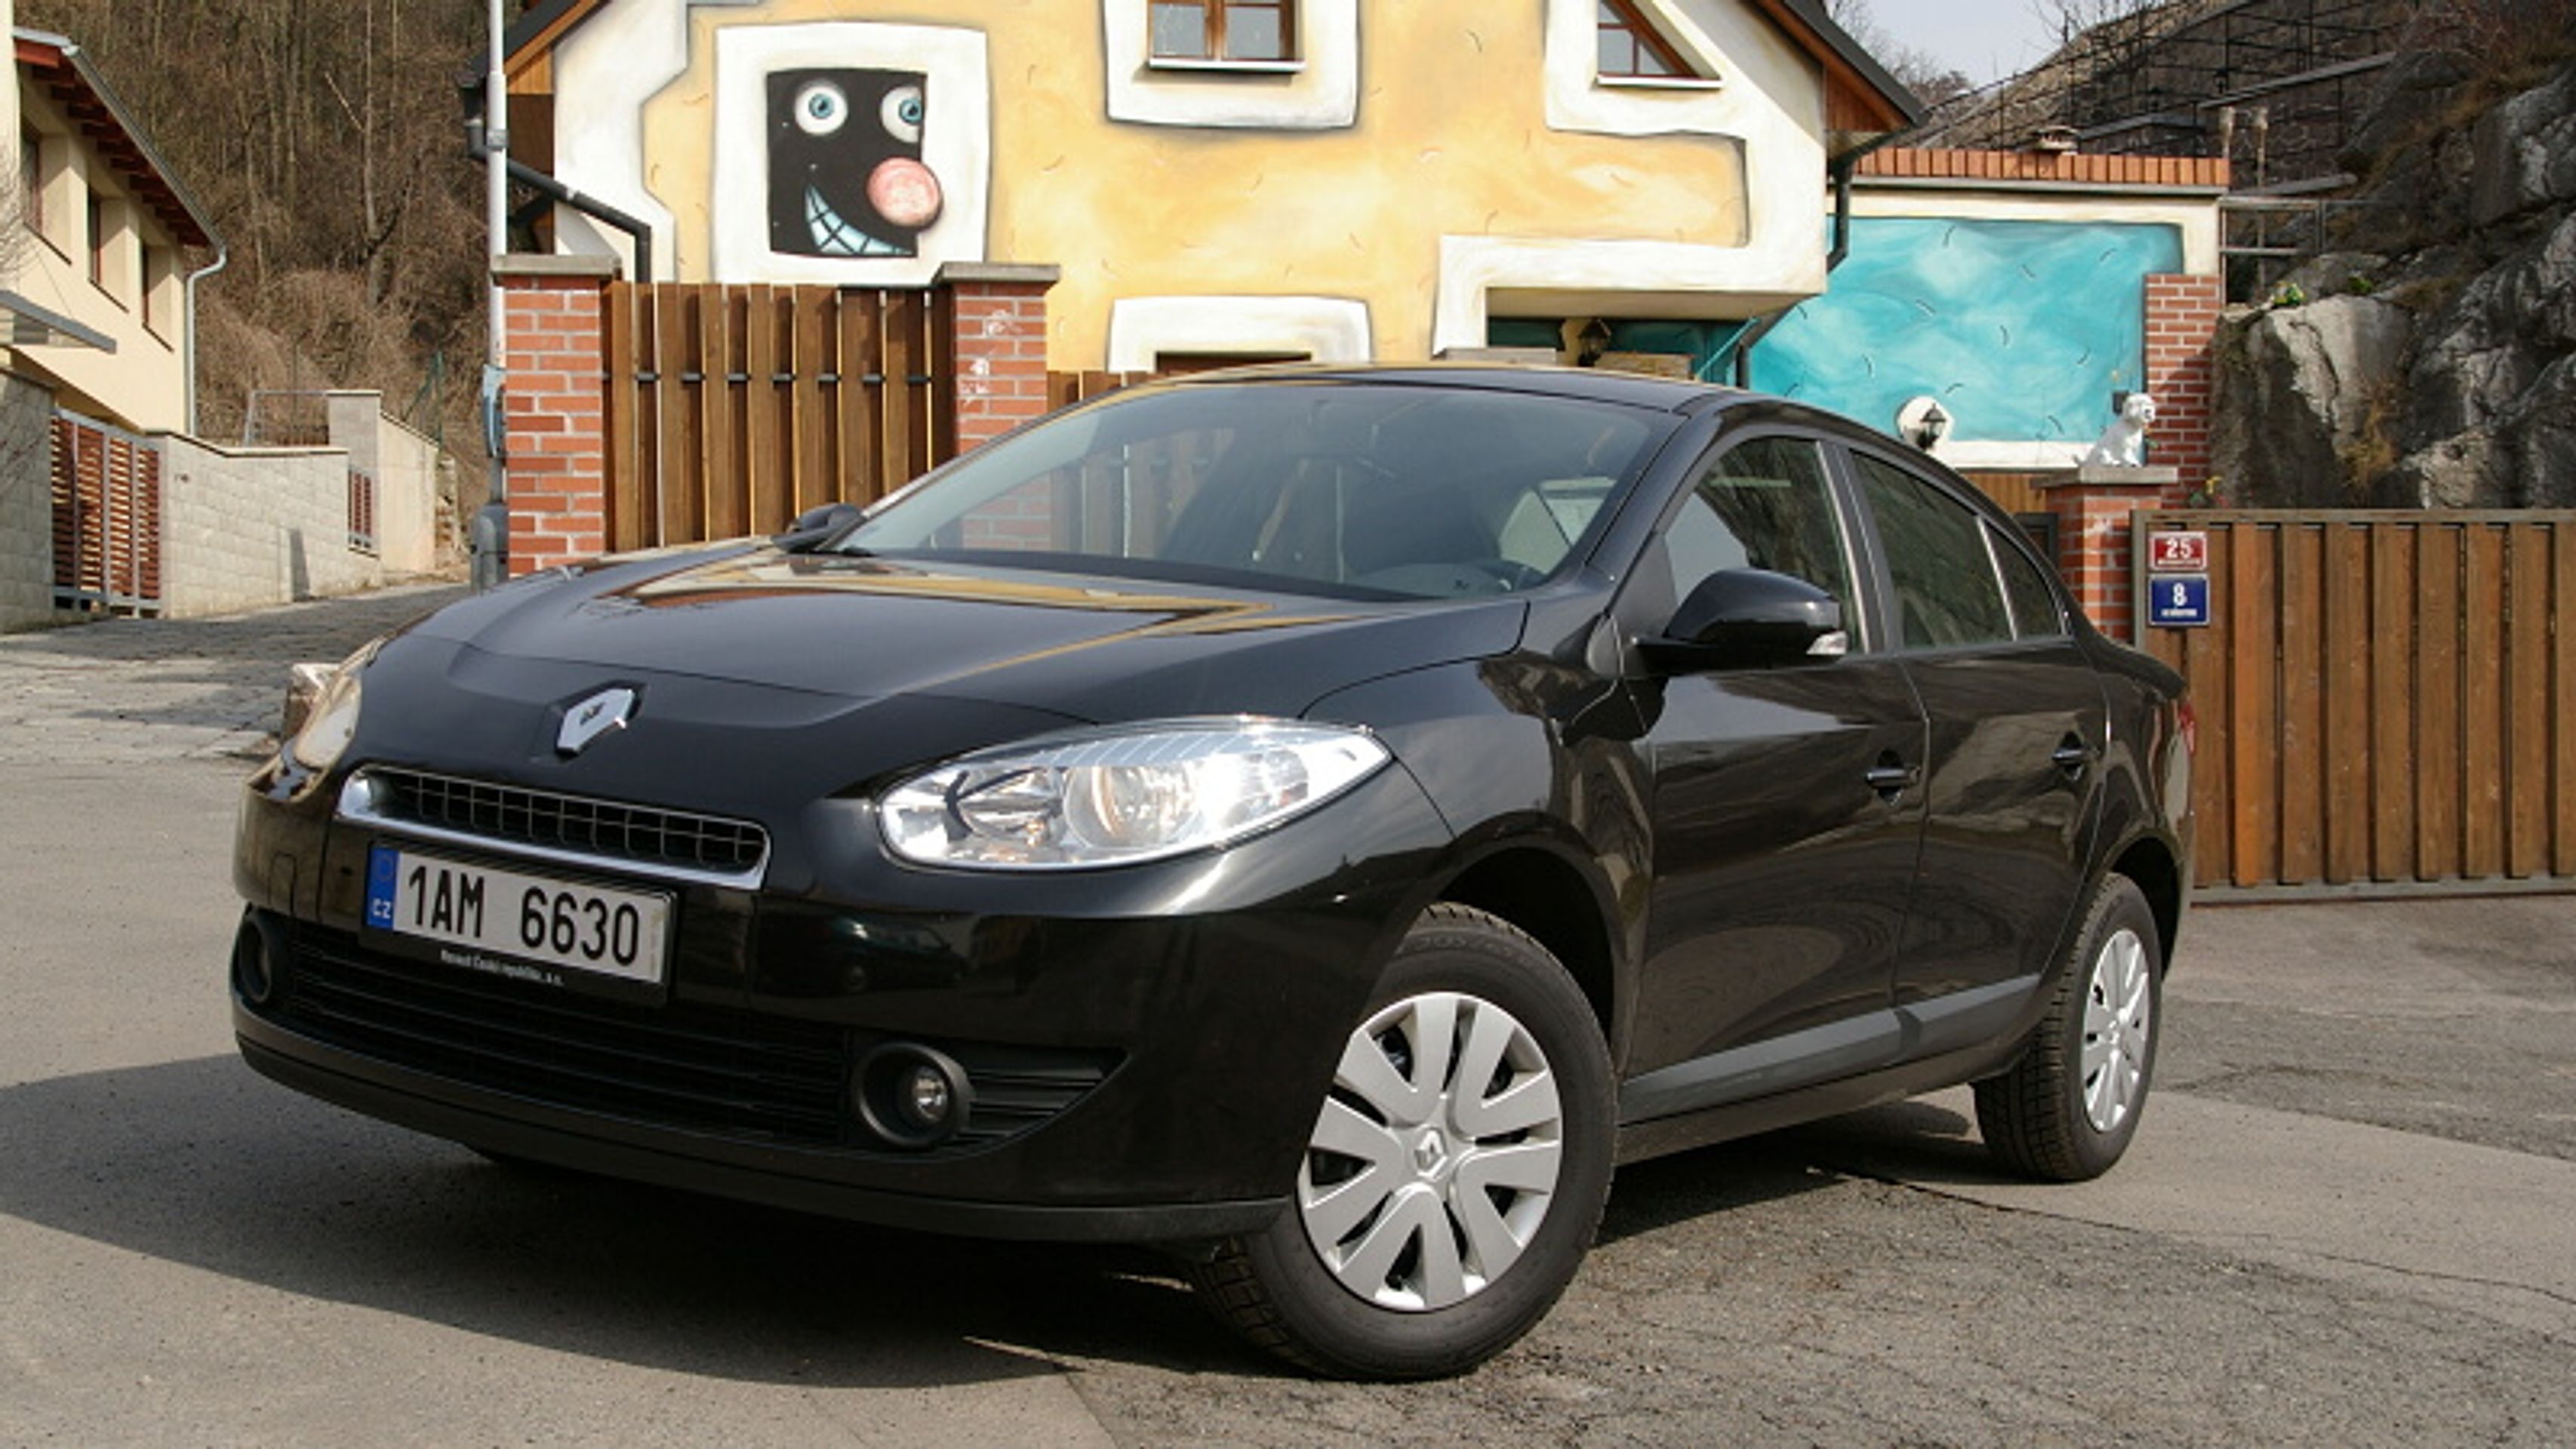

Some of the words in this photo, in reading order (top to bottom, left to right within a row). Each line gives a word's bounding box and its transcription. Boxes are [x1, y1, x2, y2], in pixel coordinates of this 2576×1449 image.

[2166, 538, 2193, 559] 25
[2173, 582, 2188, 606] 8
[408, 865, 485, 939] 1AM
[521, 885, 639, 967] 6630
